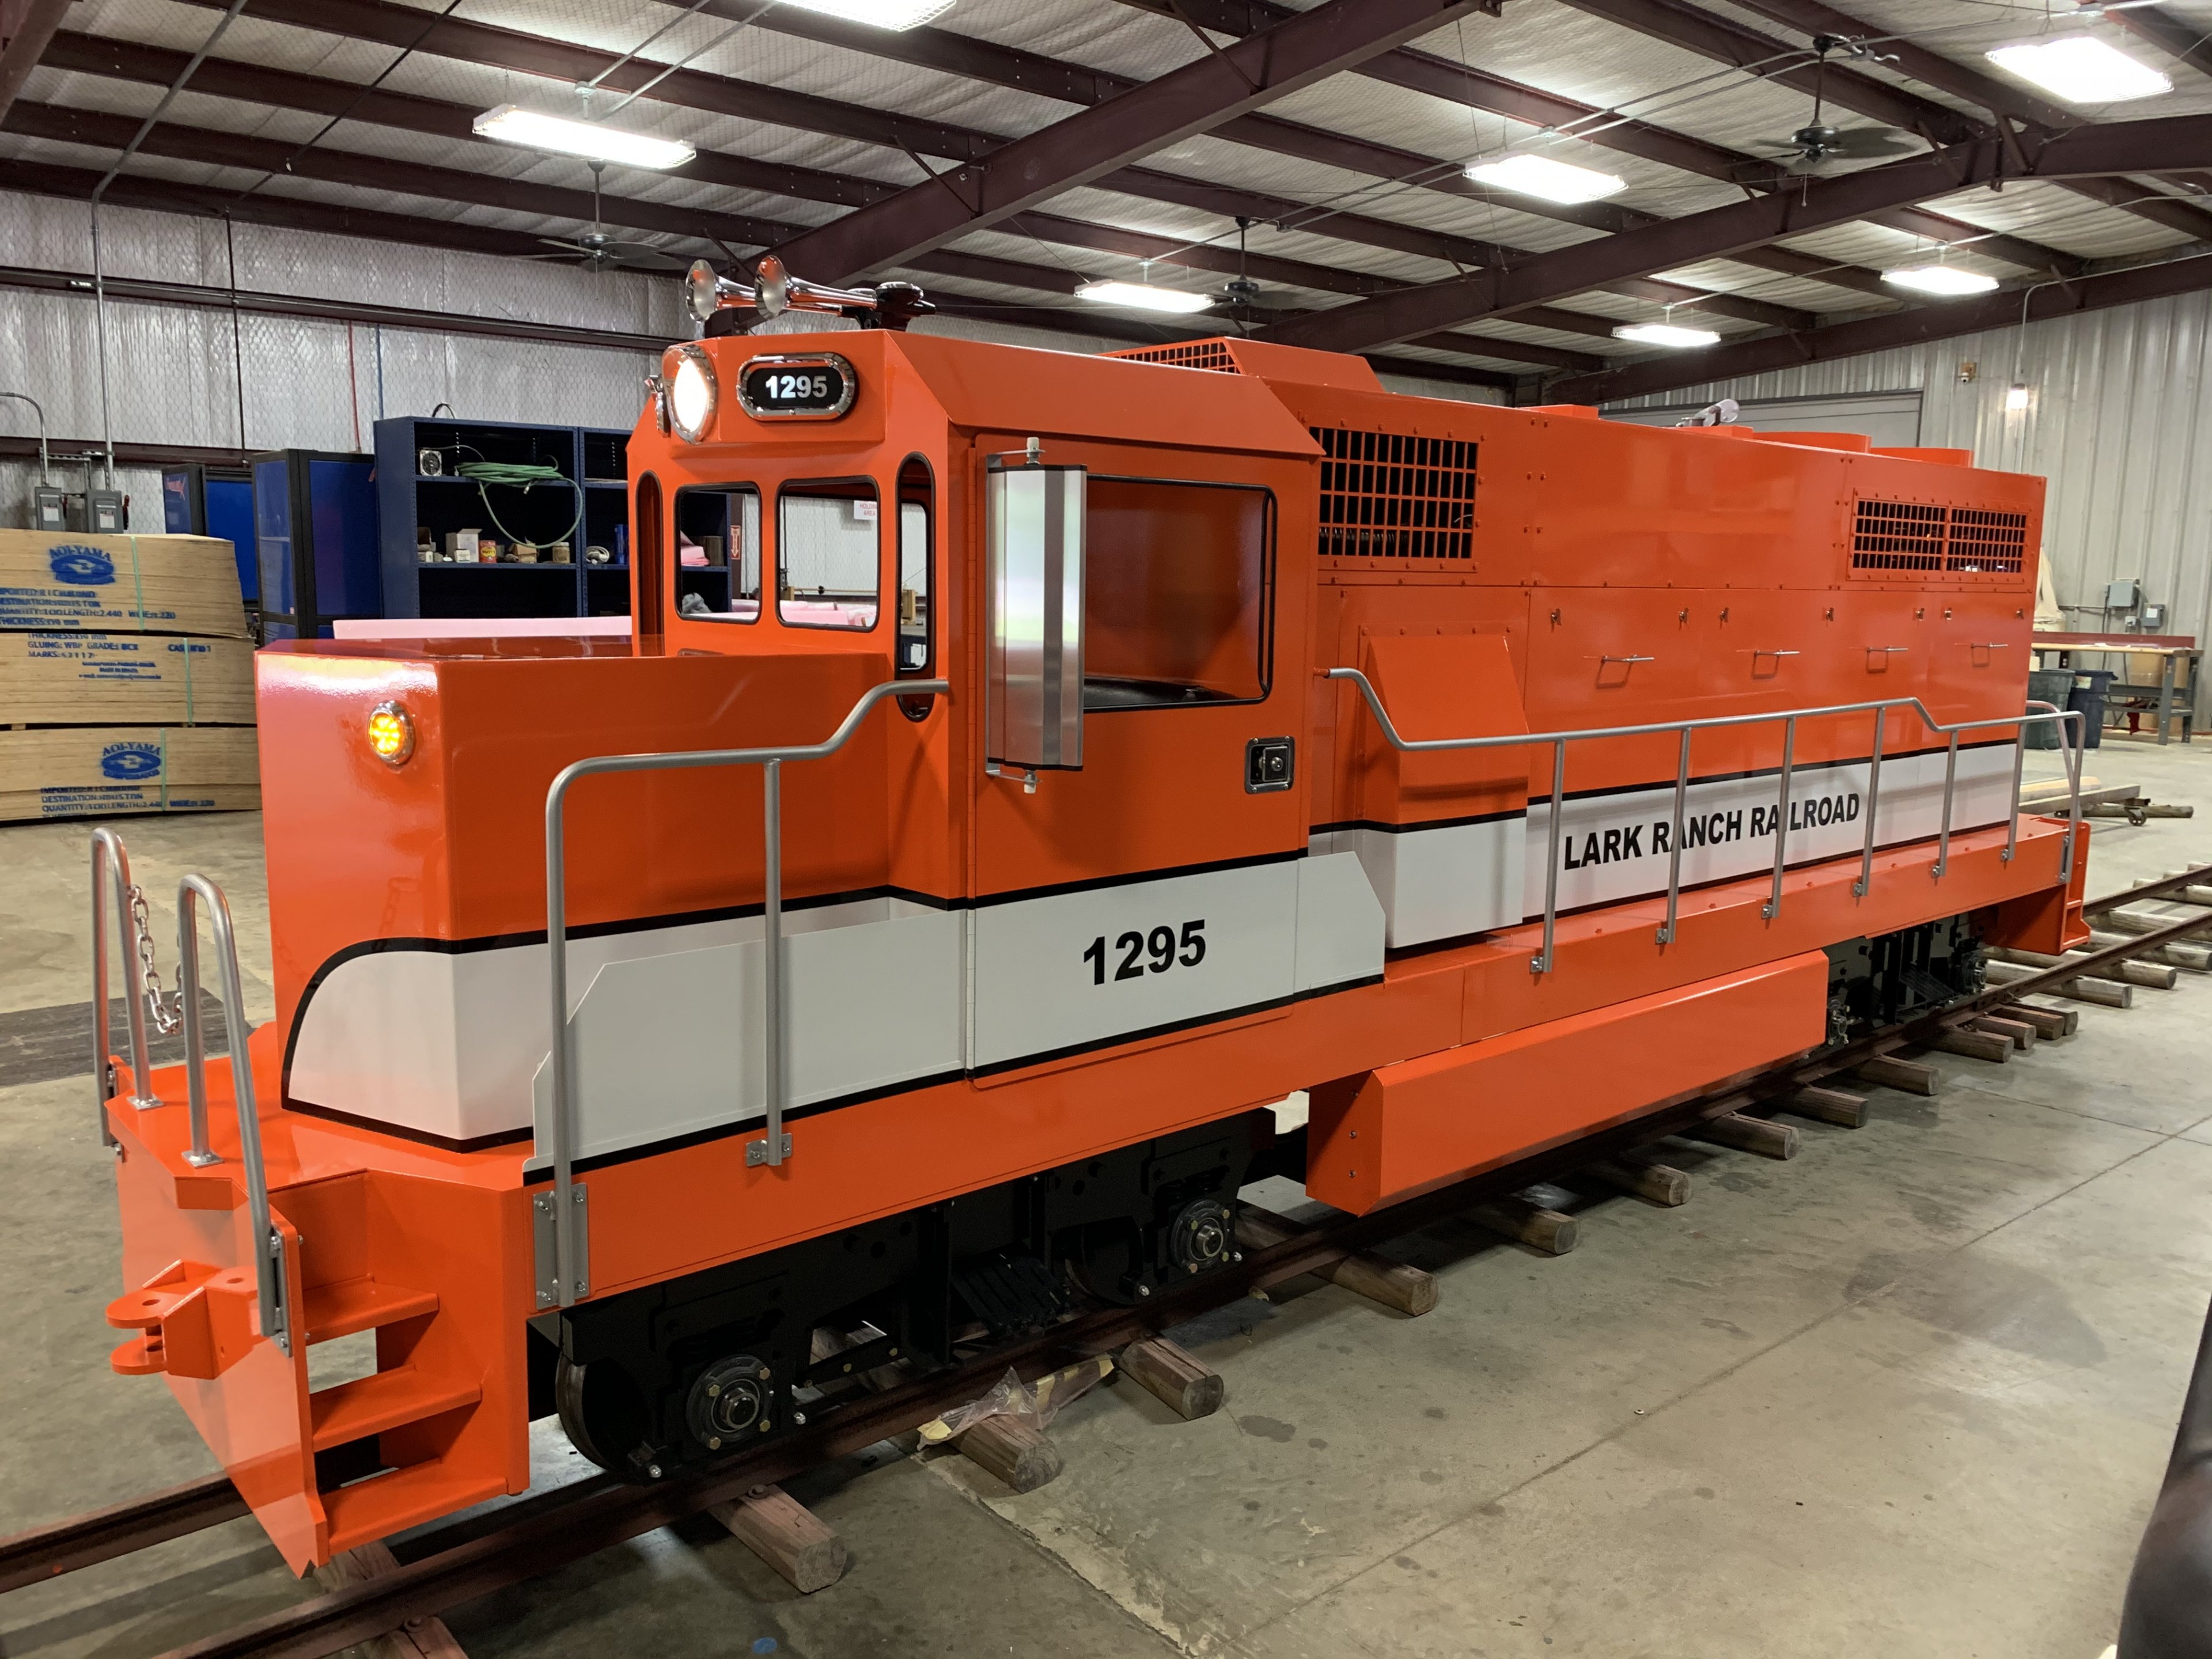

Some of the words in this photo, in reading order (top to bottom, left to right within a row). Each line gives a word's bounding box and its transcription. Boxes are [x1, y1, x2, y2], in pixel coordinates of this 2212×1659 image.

[766, 376, 828, 398] 1295
[1565, 824, 1643, 870] LARK
[1750, 793, 1859, 838] RALROAD
[1084, 919, 1206, 985] 1295
